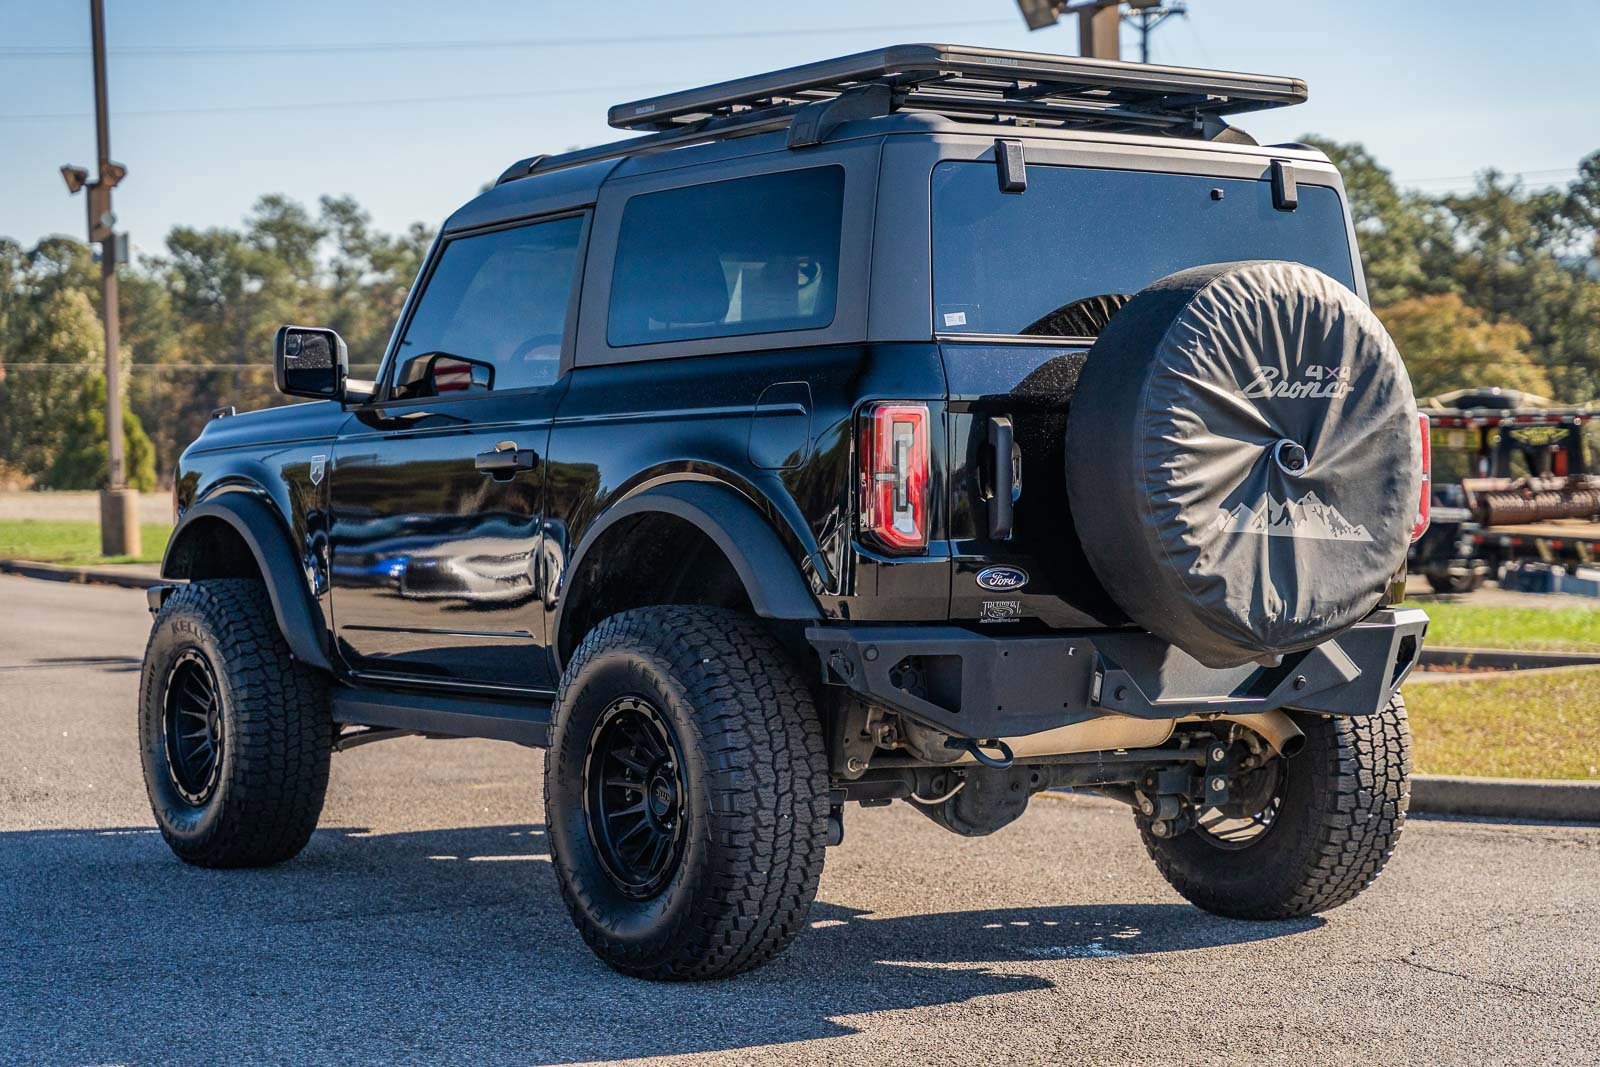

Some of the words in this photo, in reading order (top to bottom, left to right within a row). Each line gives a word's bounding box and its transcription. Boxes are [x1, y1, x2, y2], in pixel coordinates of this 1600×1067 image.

[1237, 366, 1354, 400] Bronco
[990, 572, 1016, 585] Ford
[171, 617, 208, 643] KELLY
[628, 659, 682, 724] KELLY
